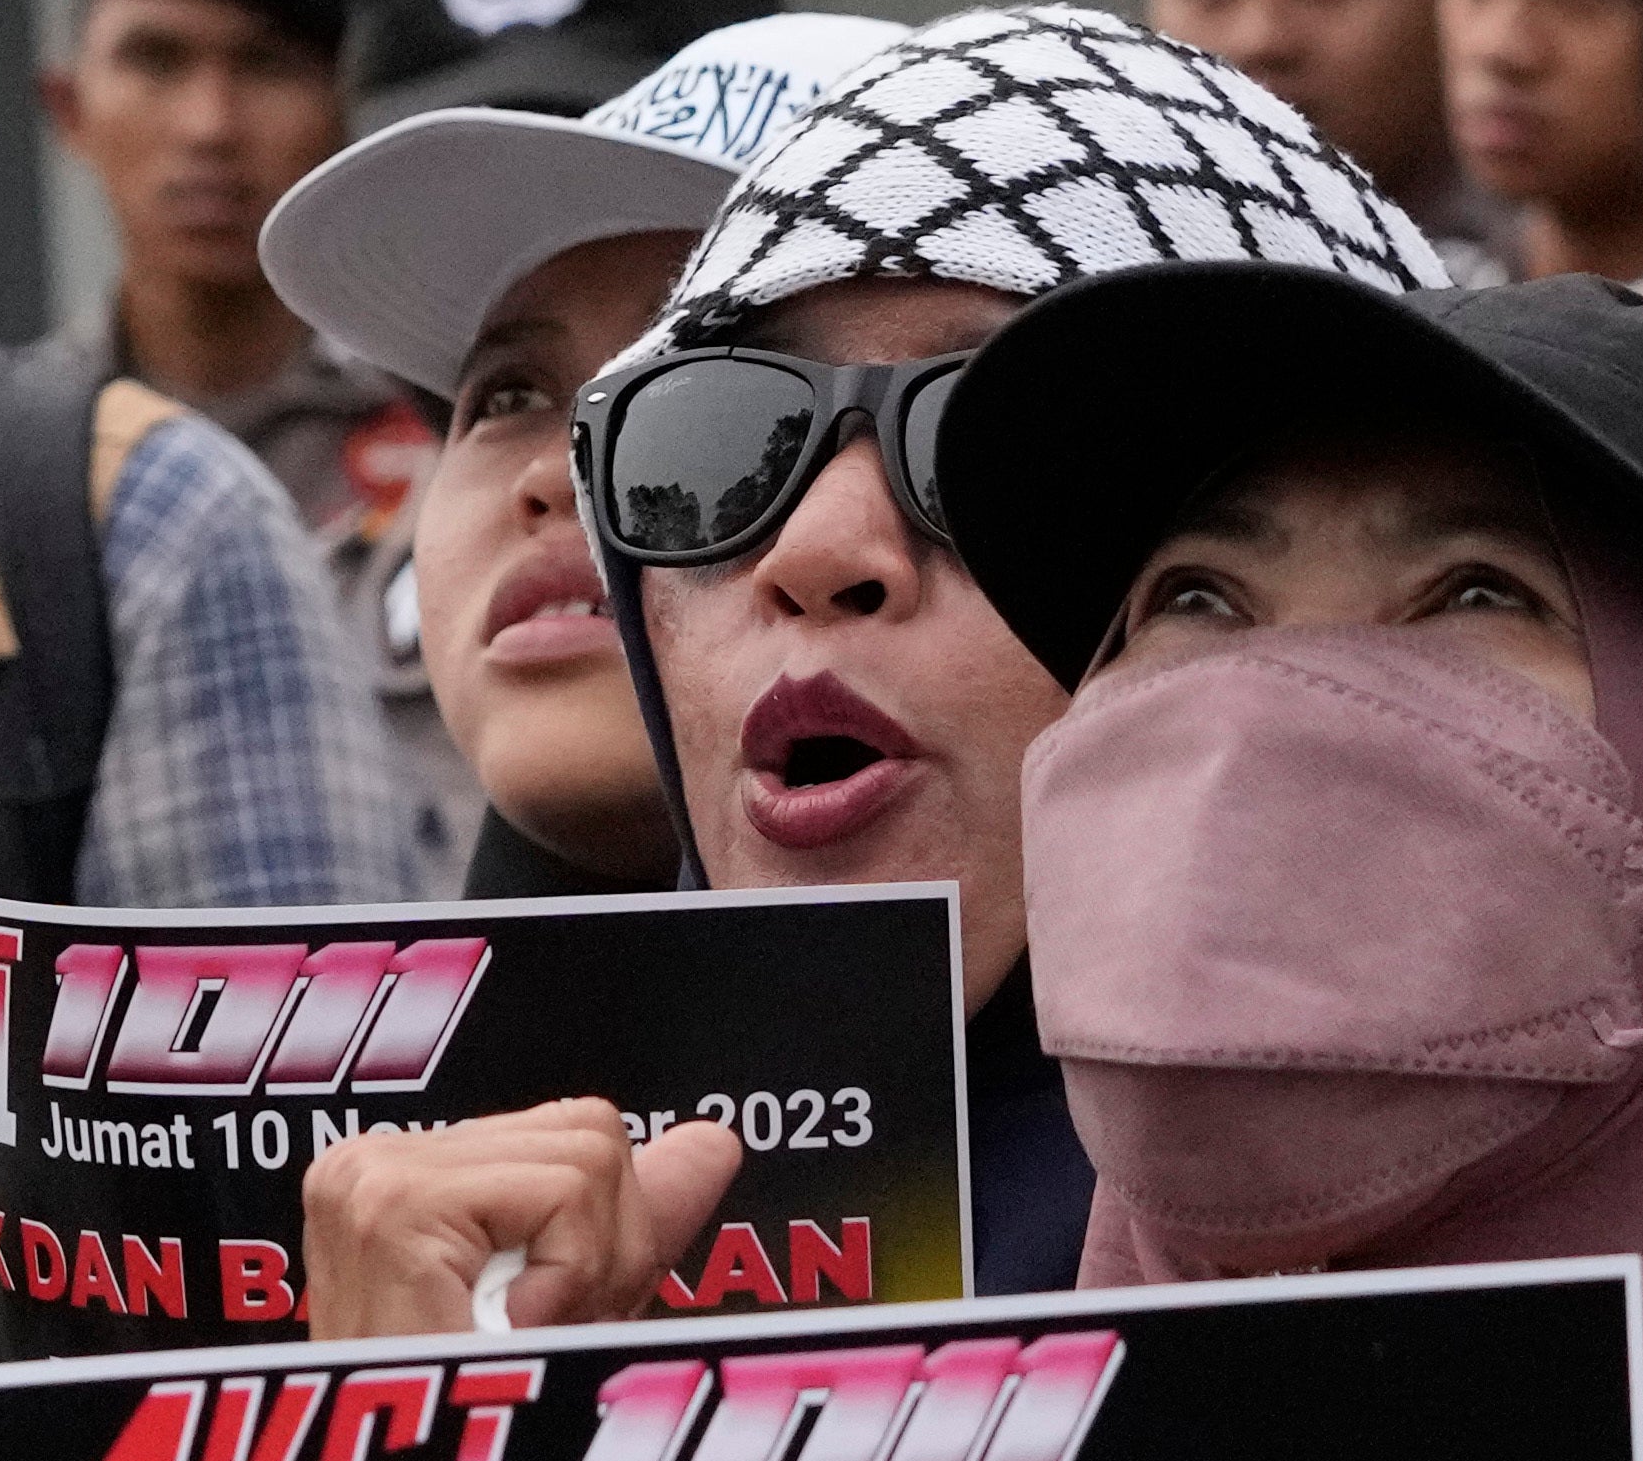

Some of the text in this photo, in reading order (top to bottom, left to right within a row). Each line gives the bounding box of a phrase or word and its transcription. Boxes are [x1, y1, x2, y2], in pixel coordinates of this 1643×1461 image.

[41, 1101, 194, 1170] Jumat
[213, 1109, 291, 1171] 10
[20, 1217, 188, 1319] DAN
